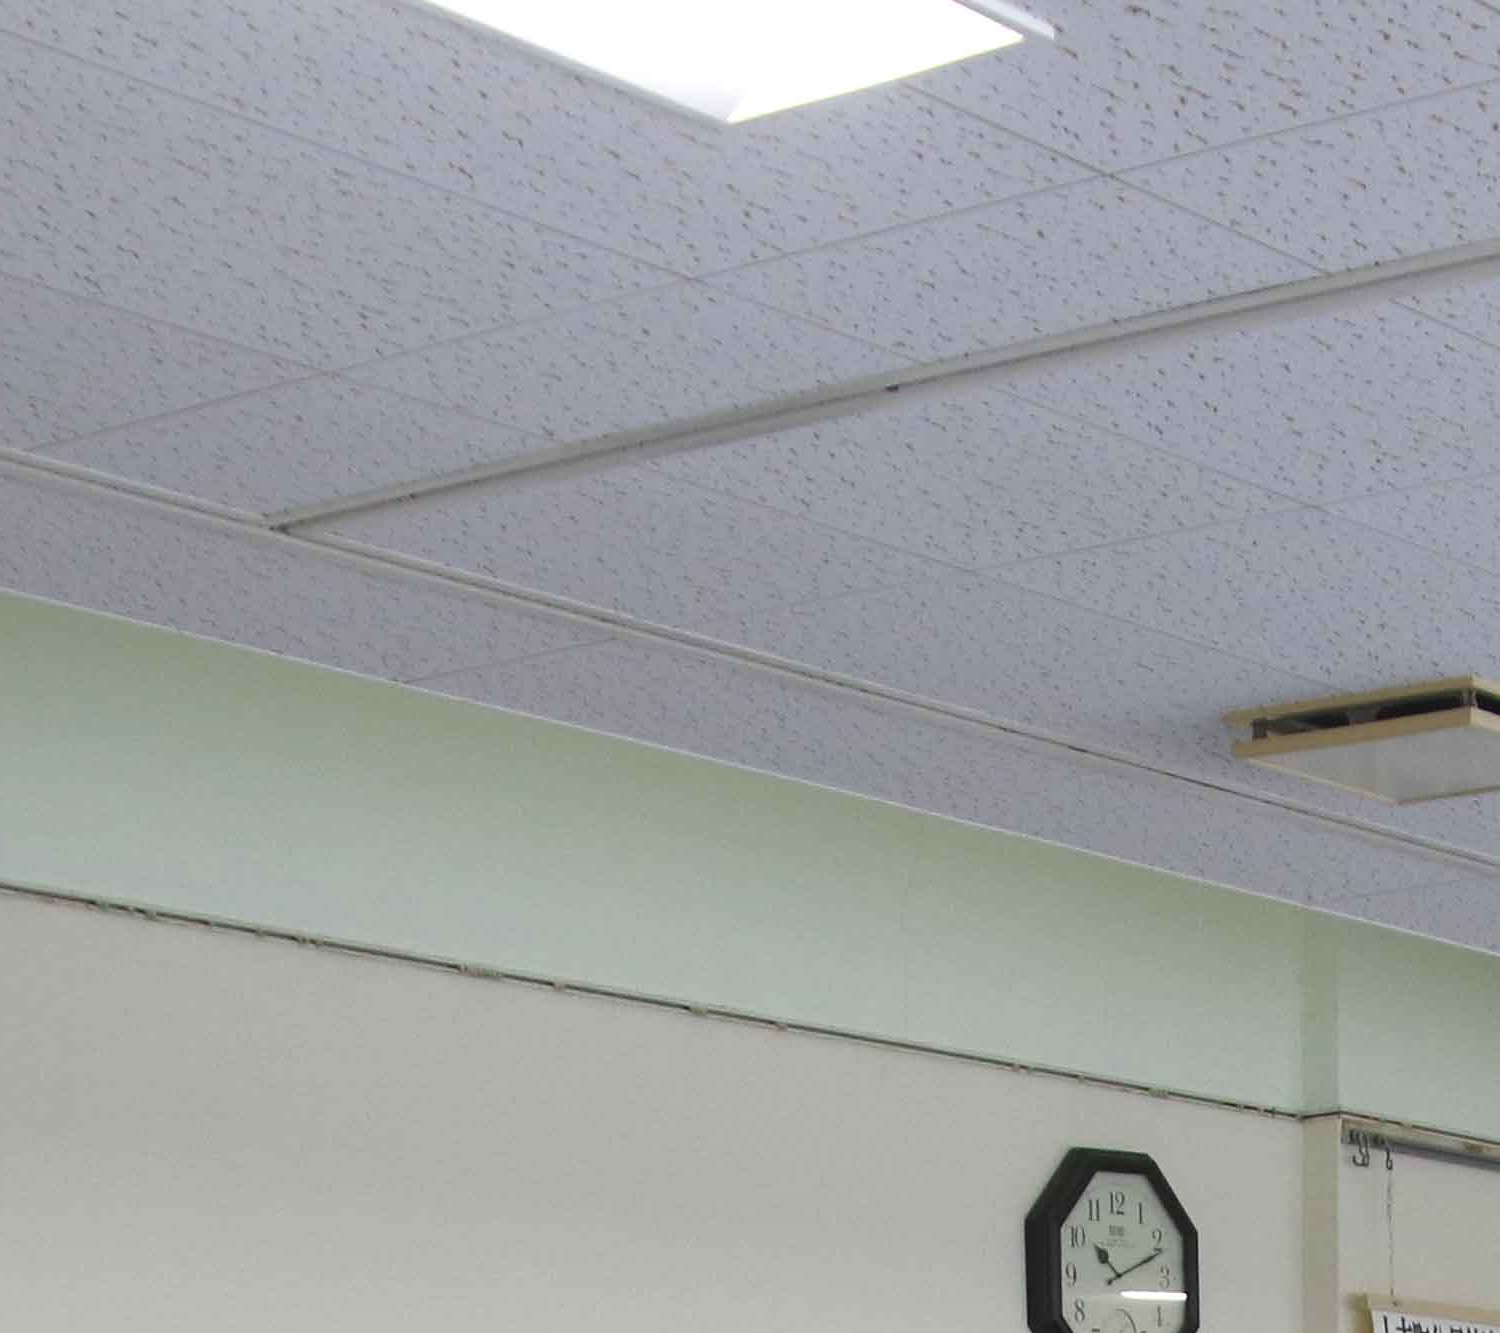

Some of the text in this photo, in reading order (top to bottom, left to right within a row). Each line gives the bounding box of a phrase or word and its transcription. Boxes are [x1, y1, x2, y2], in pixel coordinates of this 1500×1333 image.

[1088, 1199, 1100, 1222] 11
[1109, 1191, 1125, 1215] 12
[1138, 1201, 1144, 1225] 1
[1069, 1225, 1086, 1248] 10
[1151, 1228, 1163, 1253] 2
[1065, 1263, 1077, 1288] 9
[1160, 1265, 1170, 1289] 3
[1075, 1298, 1085, 1322] 8
